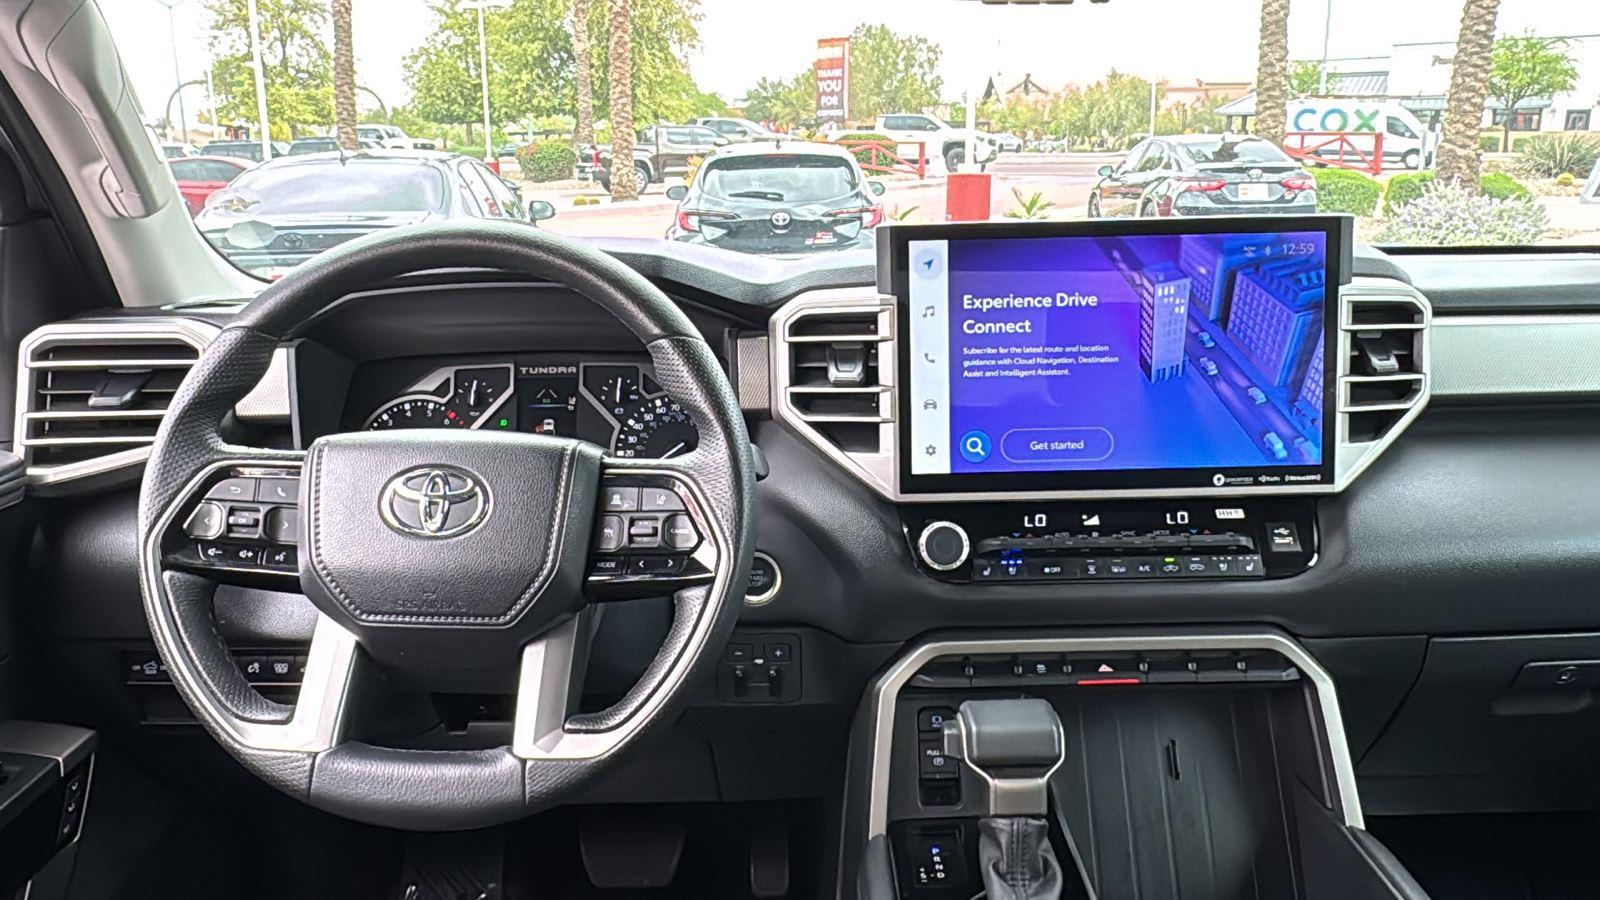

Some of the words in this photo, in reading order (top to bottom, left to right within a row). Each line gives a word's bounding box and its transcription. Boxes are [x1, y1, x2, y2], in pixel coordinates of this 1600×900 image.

[818, 80, 842, 92] YOU
[1293, 108, 1379, 132] COX
[1282, 242, 1315, 255] 12:59
[963, 294, 1052, 312] Experience
[1056, 291, 1098, 307] Drive
[962, 319, 1032, 334] Connect
[963, 347, 997, 355] Subscribe
[999, 346, 1009, 354] for
[1010, 346, 1022, 354] the
[1044, 345, 1063, 353] route
[1064, 345, 1079, 353] and
[1080, 344, 1109, 352] location
[963, 359, 996, 368] guidance
[1036, 356, 1077, 366] Navigation,
[1078, 355, 1119, 364] Destination
[519, 366, 577, 374] TUNDRA
[963, 370, 984, 378] Assist
[1000, 369, 1036, 378] Intelligent
[671, 404, 680, 412] 70
[643, 413, 654, 421] 50
[633, 423, 644, 431] 40
[1030, 441, 1048, 451] Get
[1050, 440, 1084, 450] started
[1024, 513, 1046, 528] LO
[1166, 511, 1189, 525] LO
